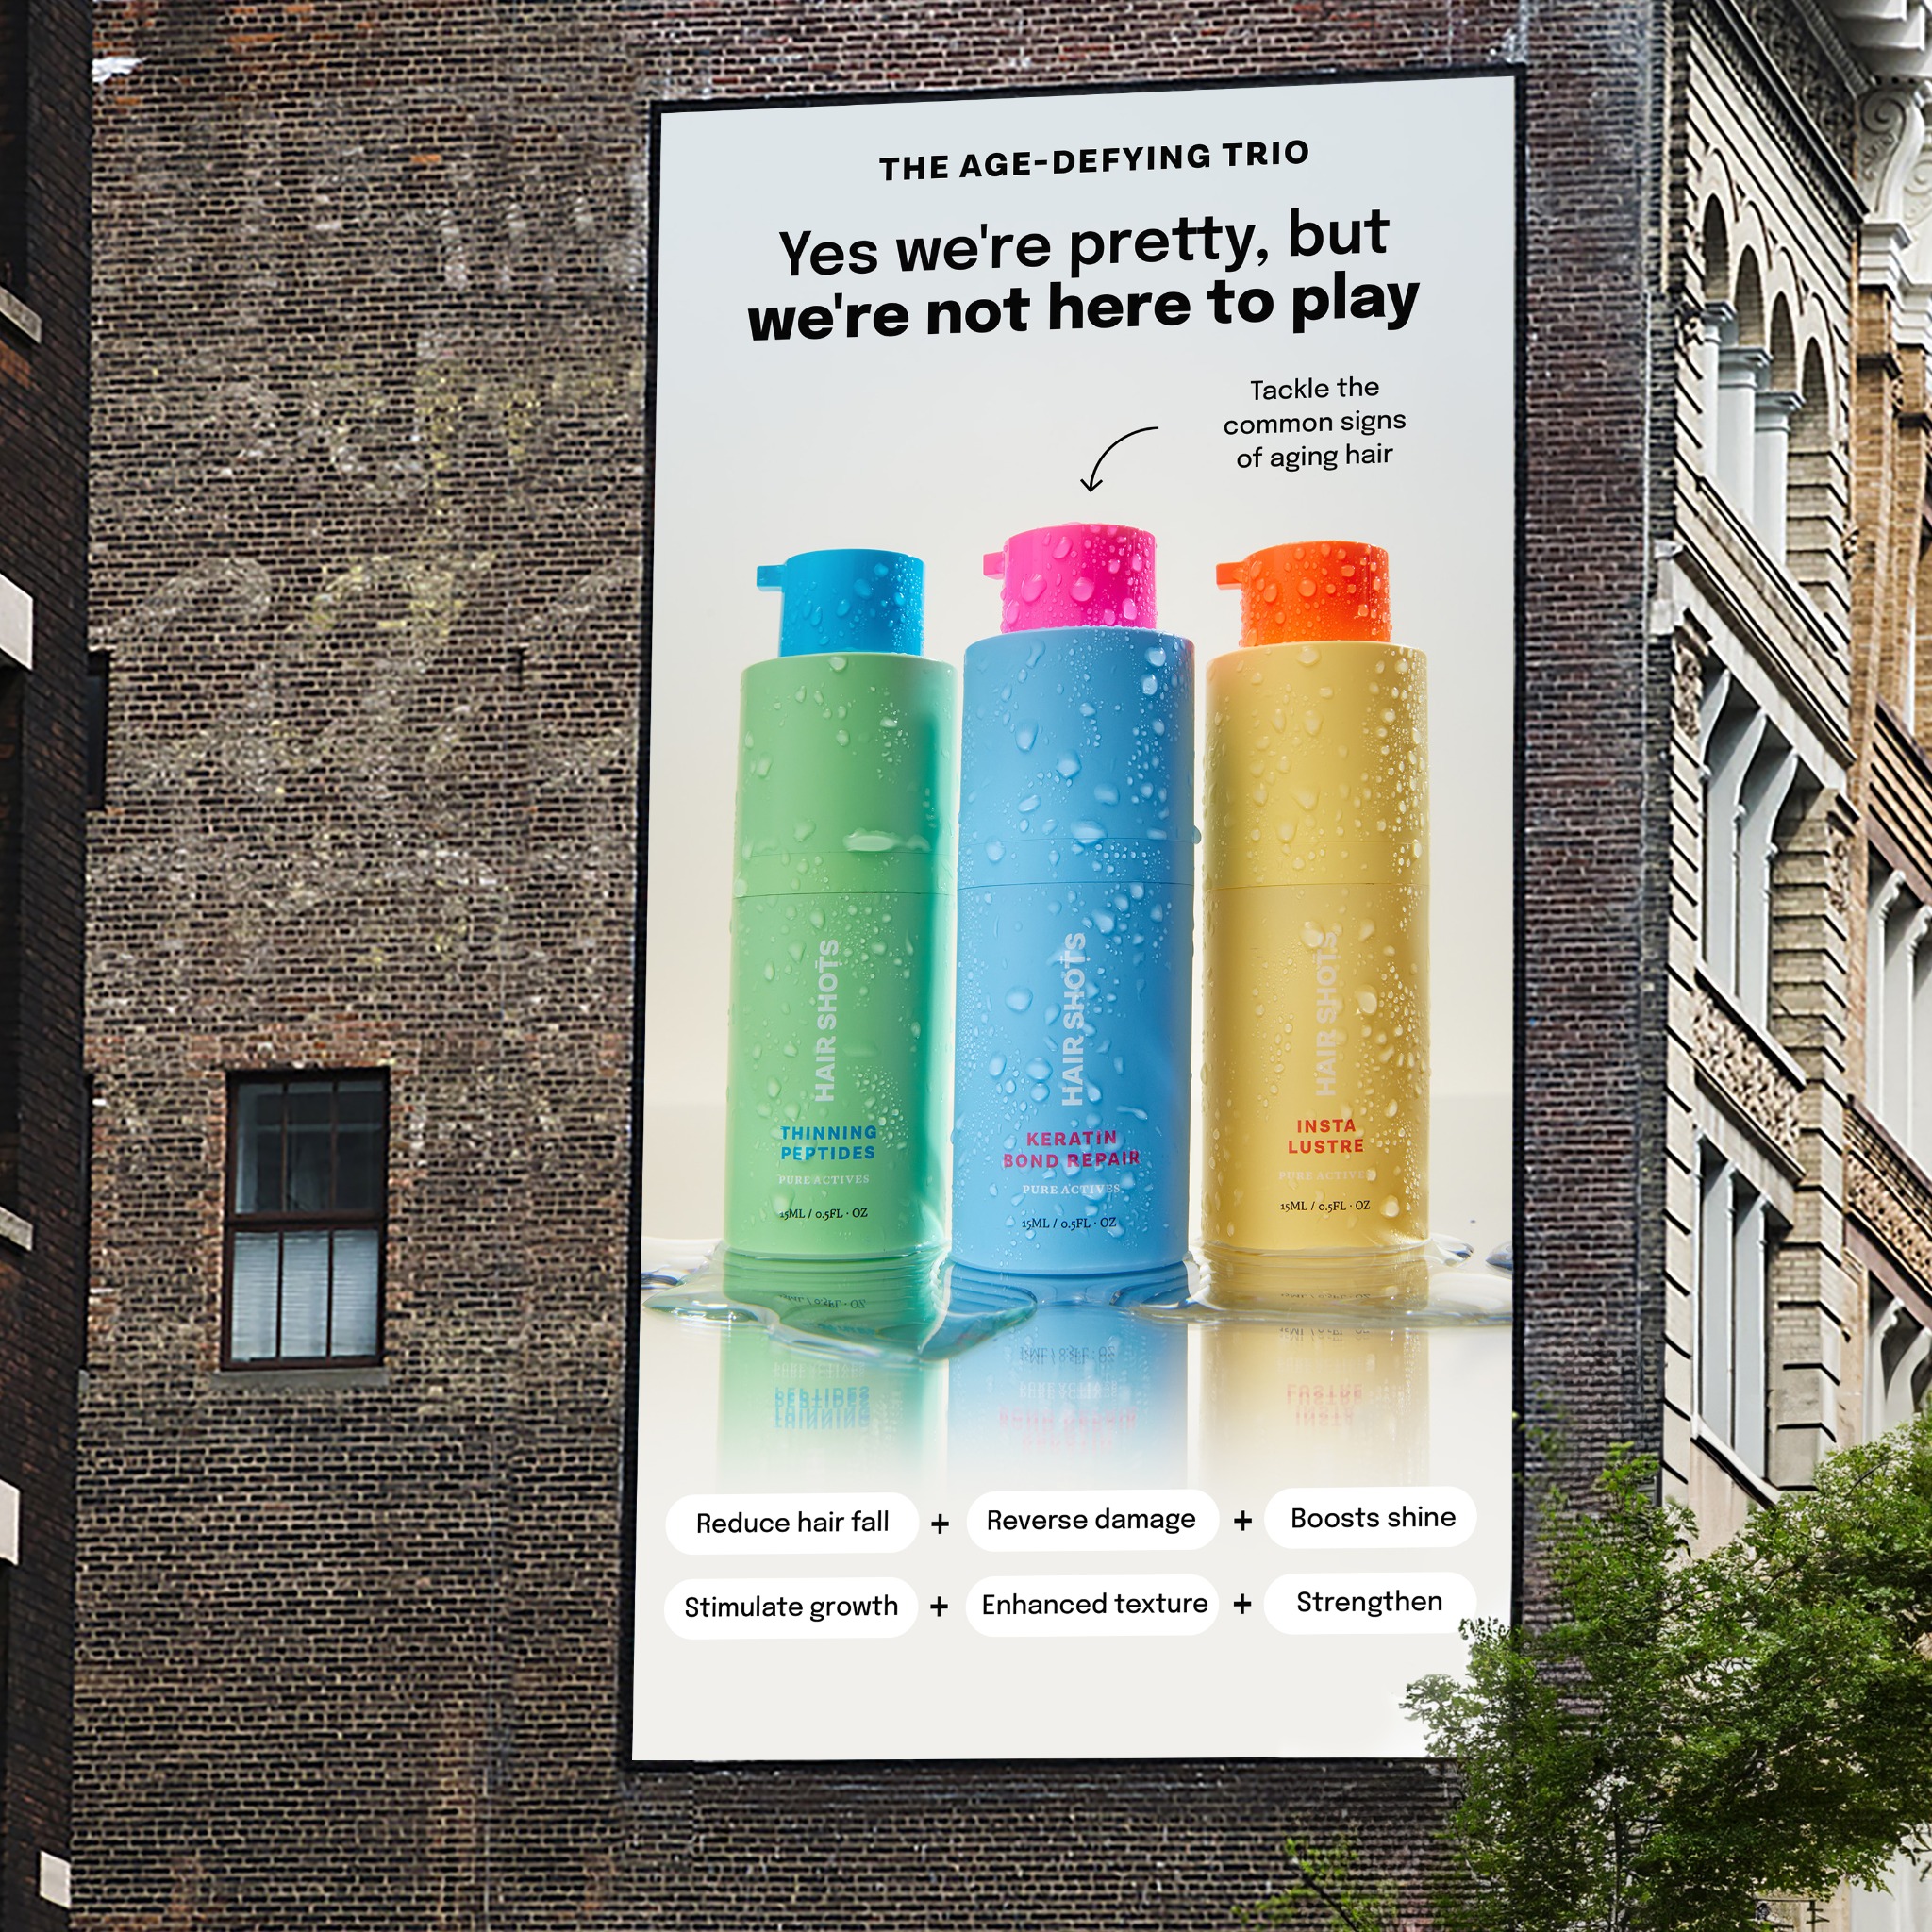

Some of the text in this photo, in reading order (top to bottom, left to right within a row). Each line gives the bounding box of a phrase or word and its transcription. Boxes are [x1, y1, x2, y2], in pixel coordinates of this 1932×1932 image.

[878, 139, 1309, 181] THE AGE-DEFYING TRIO
[778, 208, 1391, 279] Yes we're pretty, but
[747, 270, 1421, 341] we're not here to play
[1250, 375, 1380, 401] Tackle the
[1224, 409, 1407, 437] common signs
[1237, 442, 1394, 473] of aging hair
[815, 1036, 836, 1101] HAIR
[1062, 1036, 1084, 1106] HAIR
[1316, 1029, 1336, 1096] HAIR
[780, 1125, 876, 1141] THINNING
[1297, 1119, 1356, 1133] INSTA
[1026, 1130, 1117, 1146] KERATIN
[1288, 1139, 1364, 1154] LUSTRE
[781, 1146, 875, 1160] PEPTIDES
[1004, 1150, 1141, 1168] BOND REPAIR
[778, 1174, 870, 1185] PURE ACTIVES
[1278, 1171, 1313, 1180] PURE
[1023, 1183, 1120, 1194] PURE ACTIVES
[815, 1208, 843, 1221] 0.5FL
[852, 1208, 868, 1218] OZ
[1280, 1201, 1307, 1212] 15ML
[1318, 1201, 1346, 1213] 0.5FL
[1355, 1200, 1371, 1210] OZ
[1022, 1218, 1050, 1231] 15ML
[1060, 1218, 1091, 1231] 0.5FL
[1100, 1217, 1117, 1228] OZ
[697, 1511, 791, 1535] Reduce
[798, 1510, 845, 1533] hair
[851, 1509, 889, 1532] fall
[988, 1509, 1089, 1531] Reverse
[1095, 1507, 1196, 1535] damage
[1291, 1507, 1380, 1528] Boosts
[1388, 1505, 1457, 1528] shine
[685, 1594, 804, 1618] Stimulate
[809, 1593, 898, 1623] growth
[983, 1591, 1108, 1615] Enhanced
[1113, 1593, 1208, 1614] texture
[1297, 1589, 1442, 1618] Strengthen
